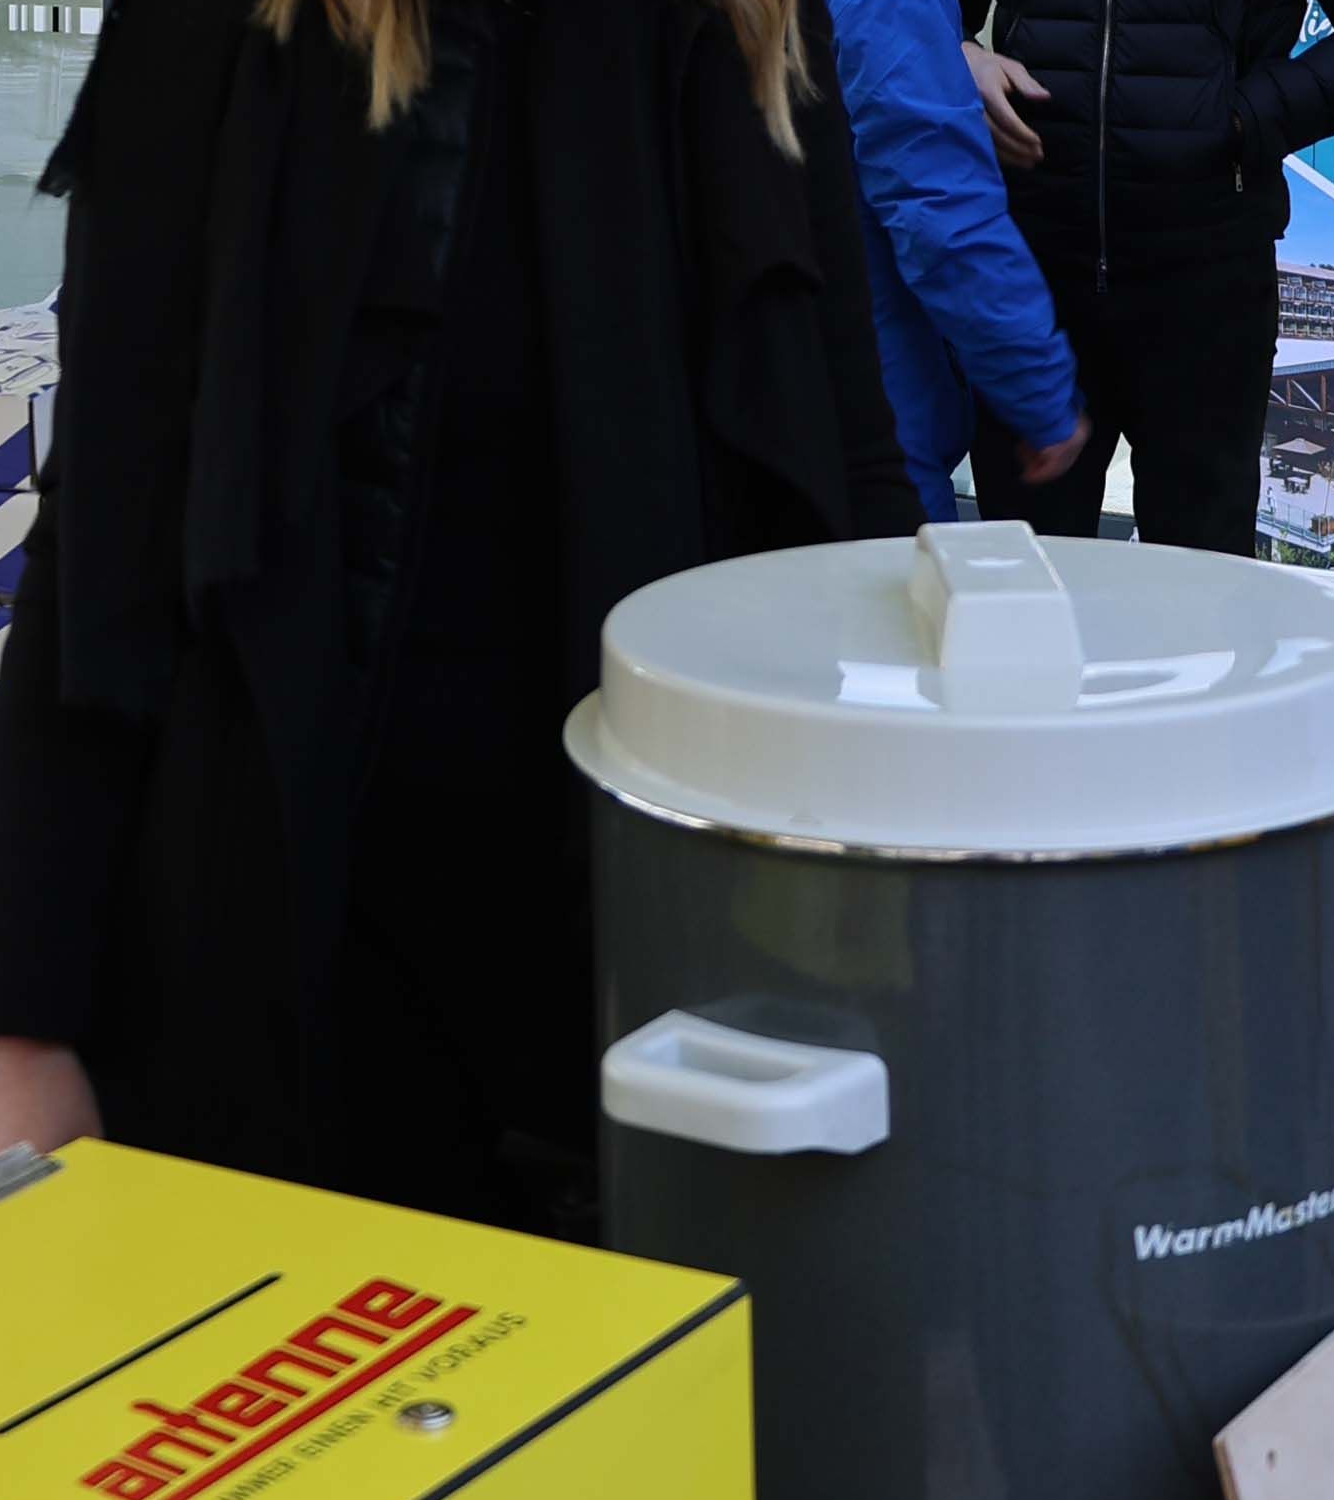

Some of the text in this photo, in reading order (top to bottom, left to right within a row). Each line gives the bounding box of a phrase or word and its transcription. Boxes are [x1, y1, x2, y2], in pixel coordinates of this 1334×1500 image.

[293, 1409, 376, 1463] EINEN
[372, 1378, 418, 1415] HIT
[419, 1310, 528, 1384] VORAUS
